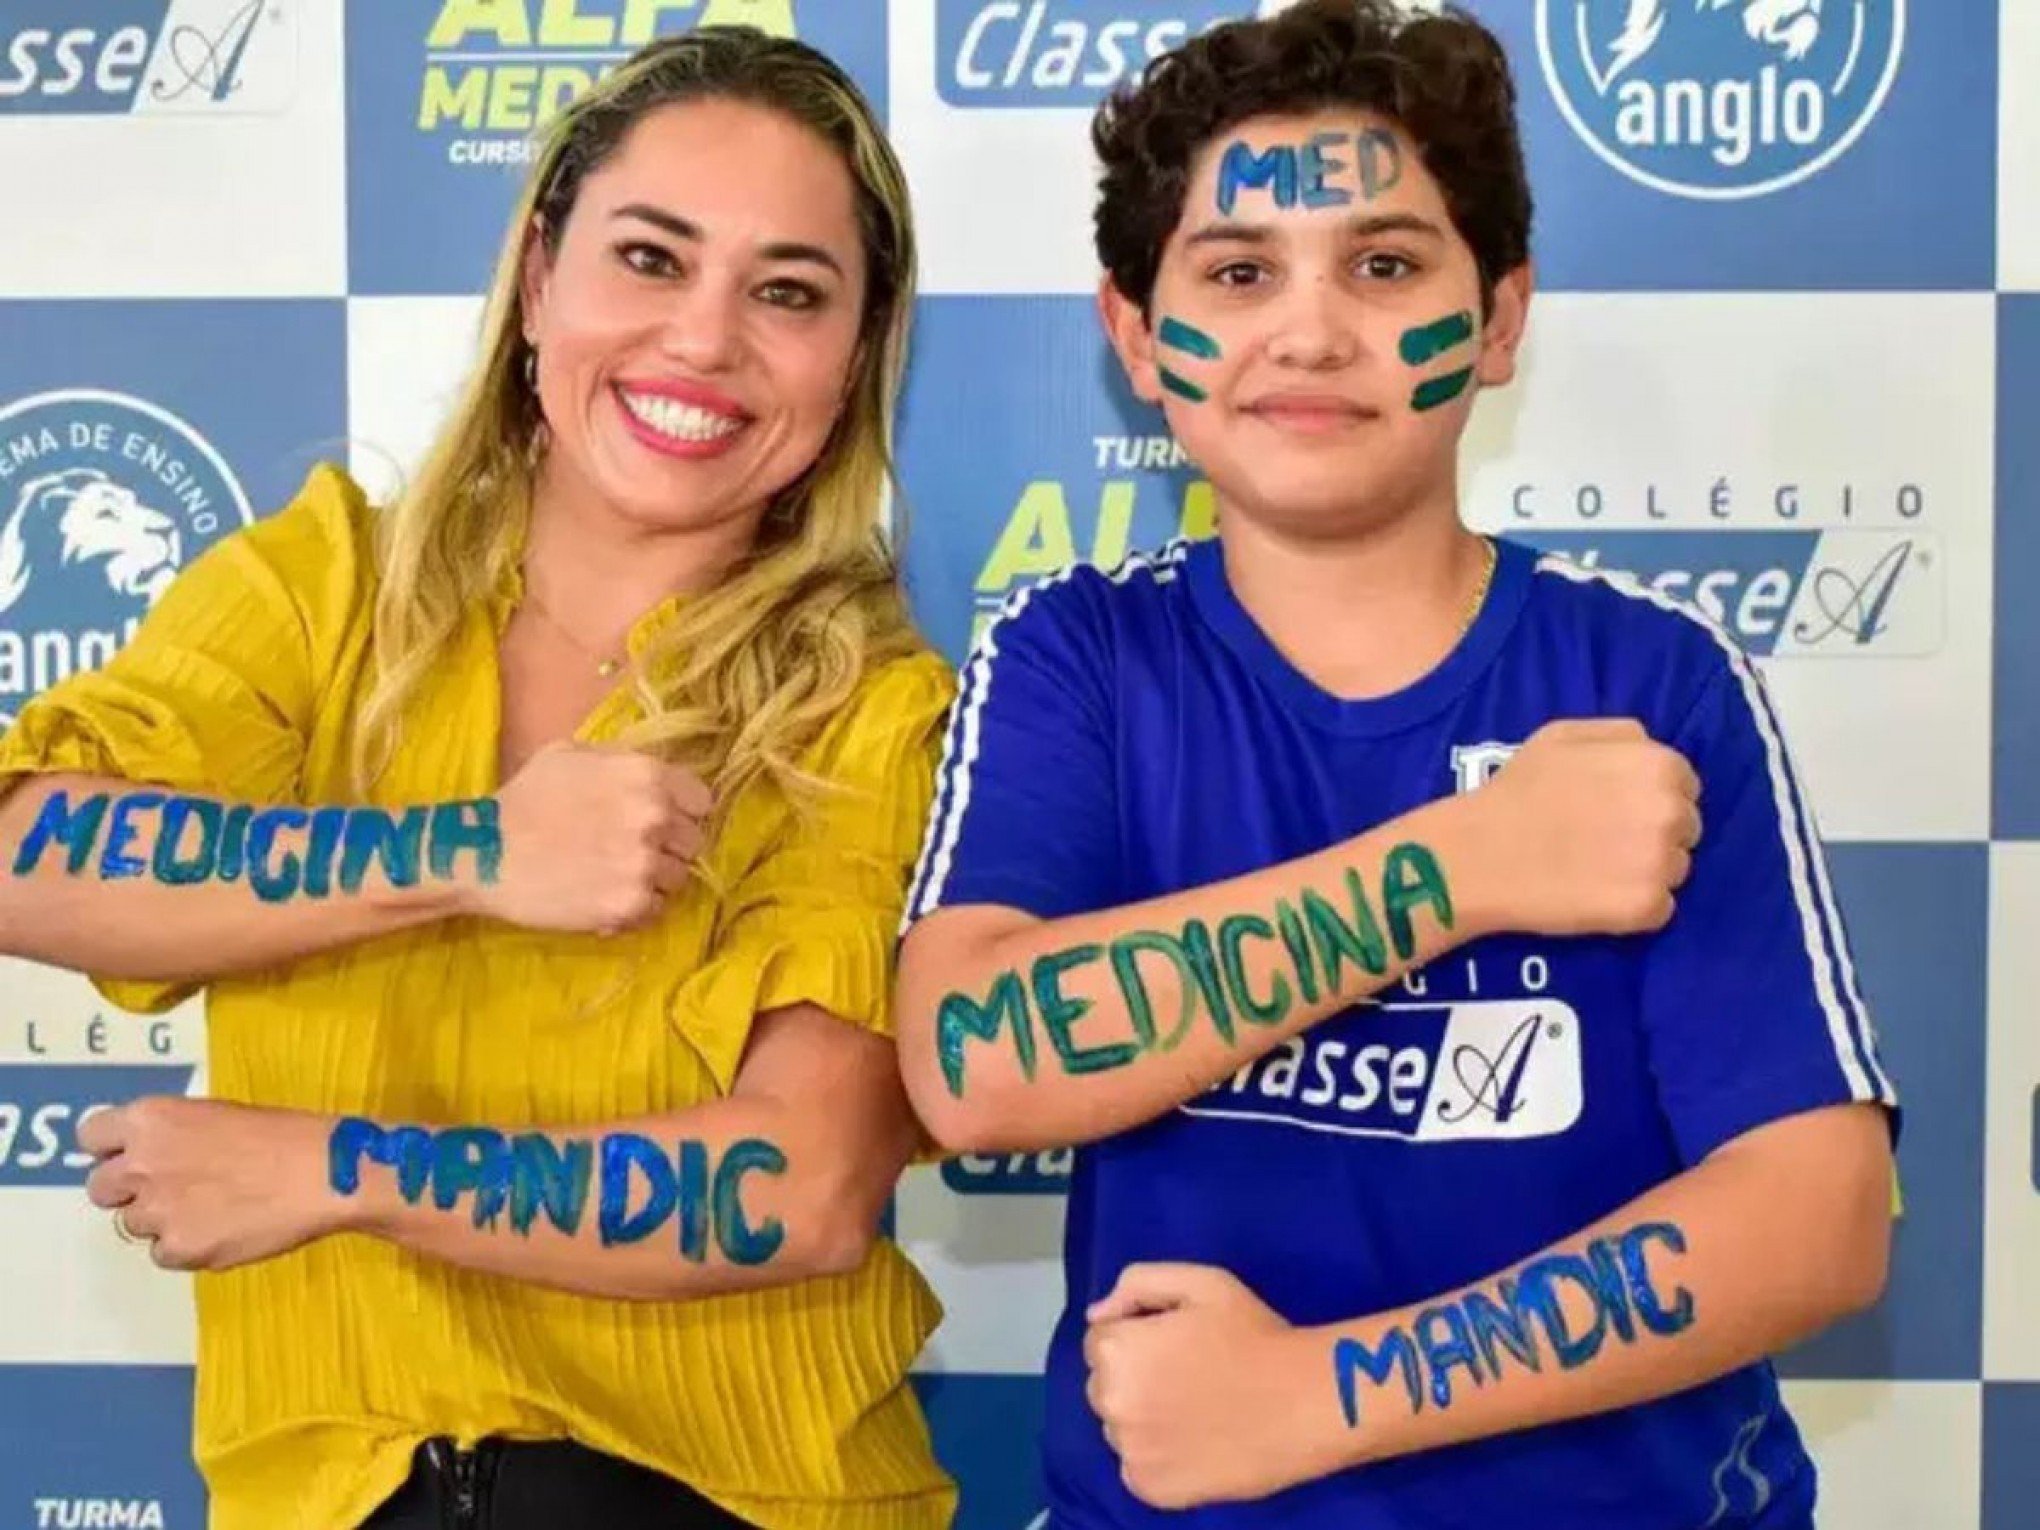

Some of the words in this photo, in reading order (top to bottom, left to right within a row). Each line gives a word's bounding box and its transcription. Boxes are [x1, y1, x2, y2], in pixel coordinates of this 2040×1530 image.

[953, 1, 1238, 88] Class
[417, 67, 614, 131] MED
[1615, 65, 1824, 166] anglo
[1216, 127, 1400, 217] MED
[69, 422, 113, 451] DE
[122, 432, 219, 534] ENSINO
[1513, 478, 1923, 518] COLÉGIO
[12, 790, 503, 902] MEDICINA
[936, 841, 1454, 1098] MEDICINA
[1211, 1036, 1428, 1115] asse
[329, 1116, 787, 1266] MANDIC
[1334, 1221, 1697, 1429] MANDIC
[33, 1498, 164, 1529] TURMA
